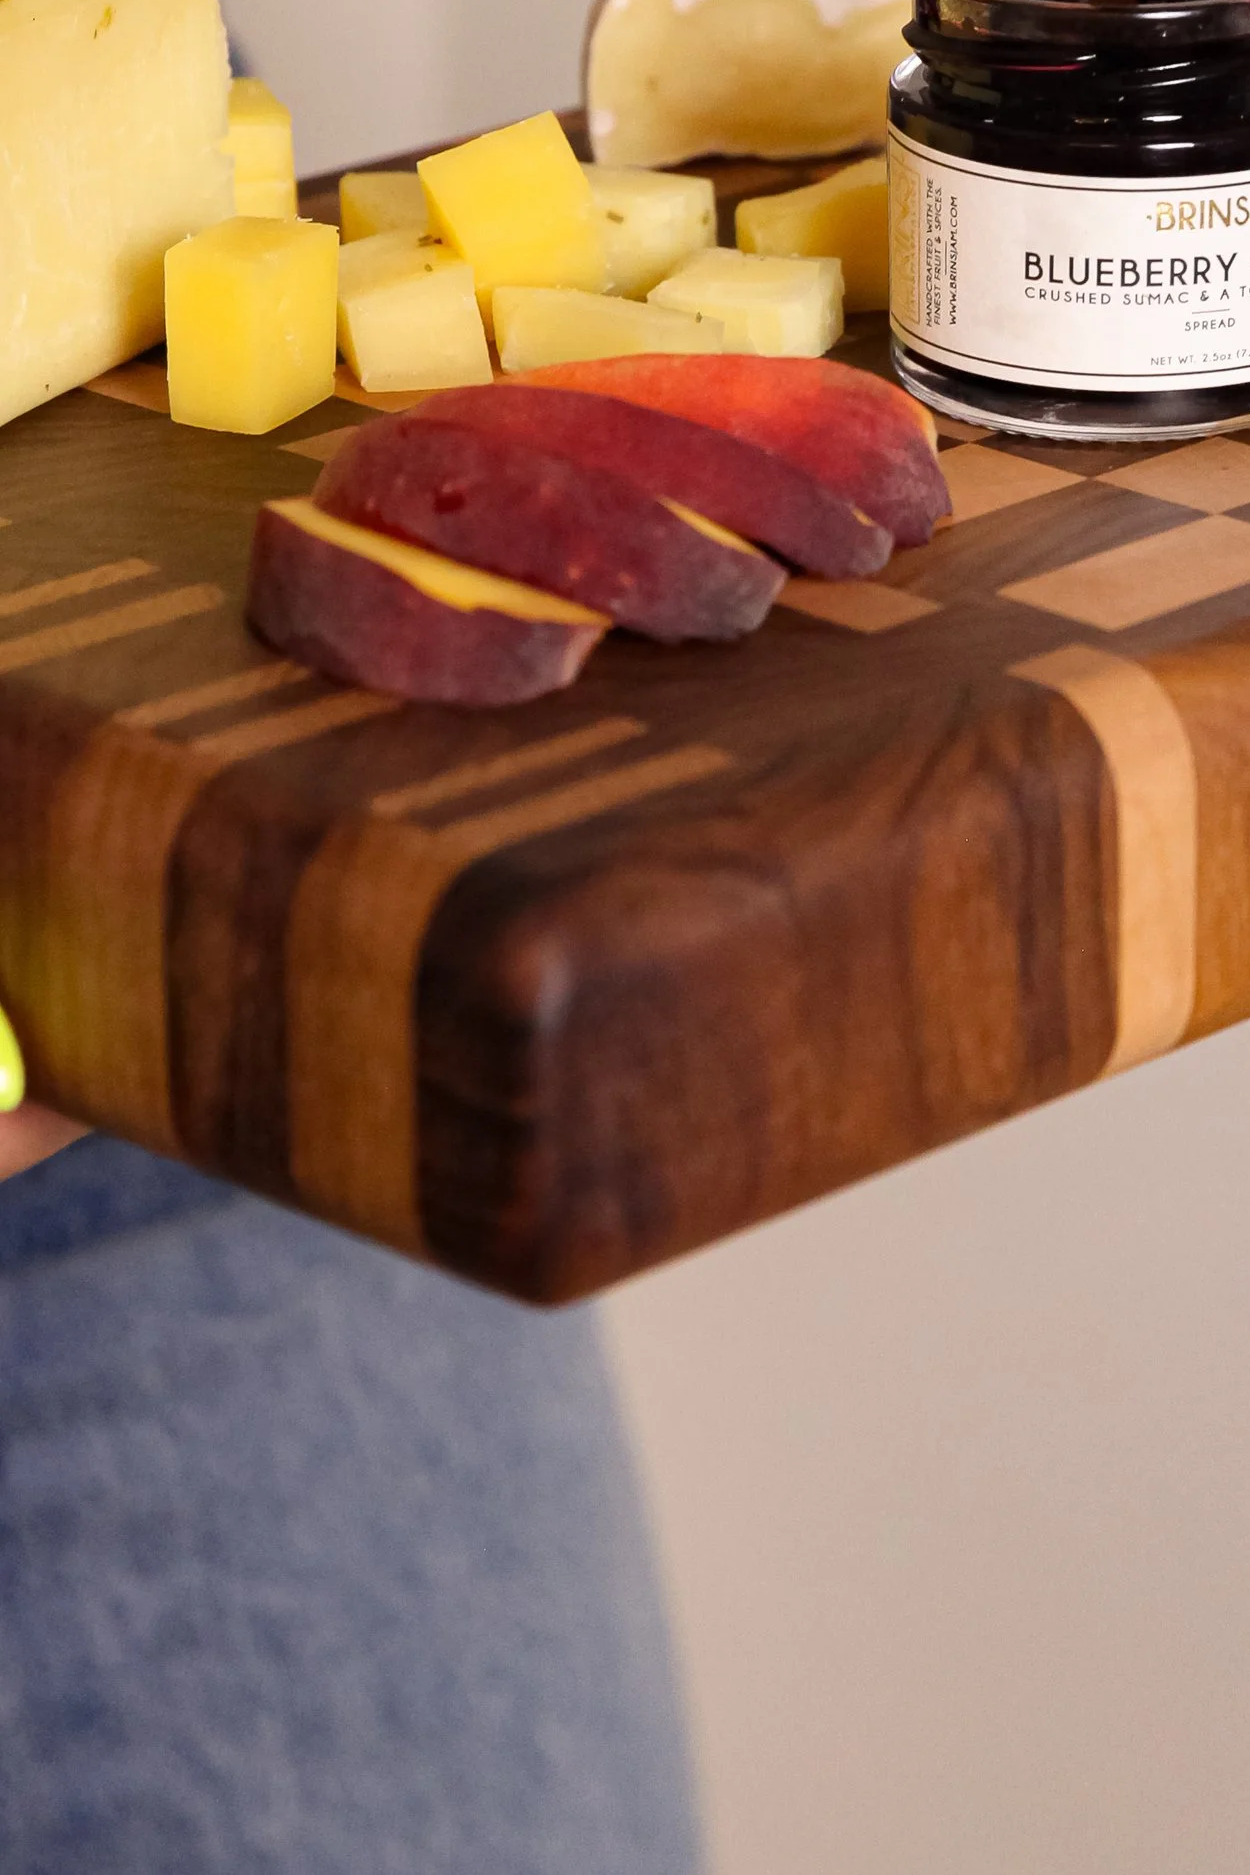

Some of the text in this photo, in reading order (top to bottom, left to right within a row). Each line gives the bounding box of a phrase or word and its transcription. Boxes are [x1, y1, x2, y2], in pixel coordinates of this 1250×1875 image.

[926, 177, 934, 199] THE
[934, 236, 941, 244] &
[949, 196, 958, 325] WWW.BRINSJAM.COM
[1025, 251, 1238, 288] BLUEBERRY
[1024, 286, 1112, 305] CRUSHED
[1122, 291, 1189, 305] SUMAC
[1199, 290, 1210, 302] &
[1219, 288, 1230, 301] A
[1184, 317, 1236, 332] SPREAD
[1150, 356, 1173, 366] NET
